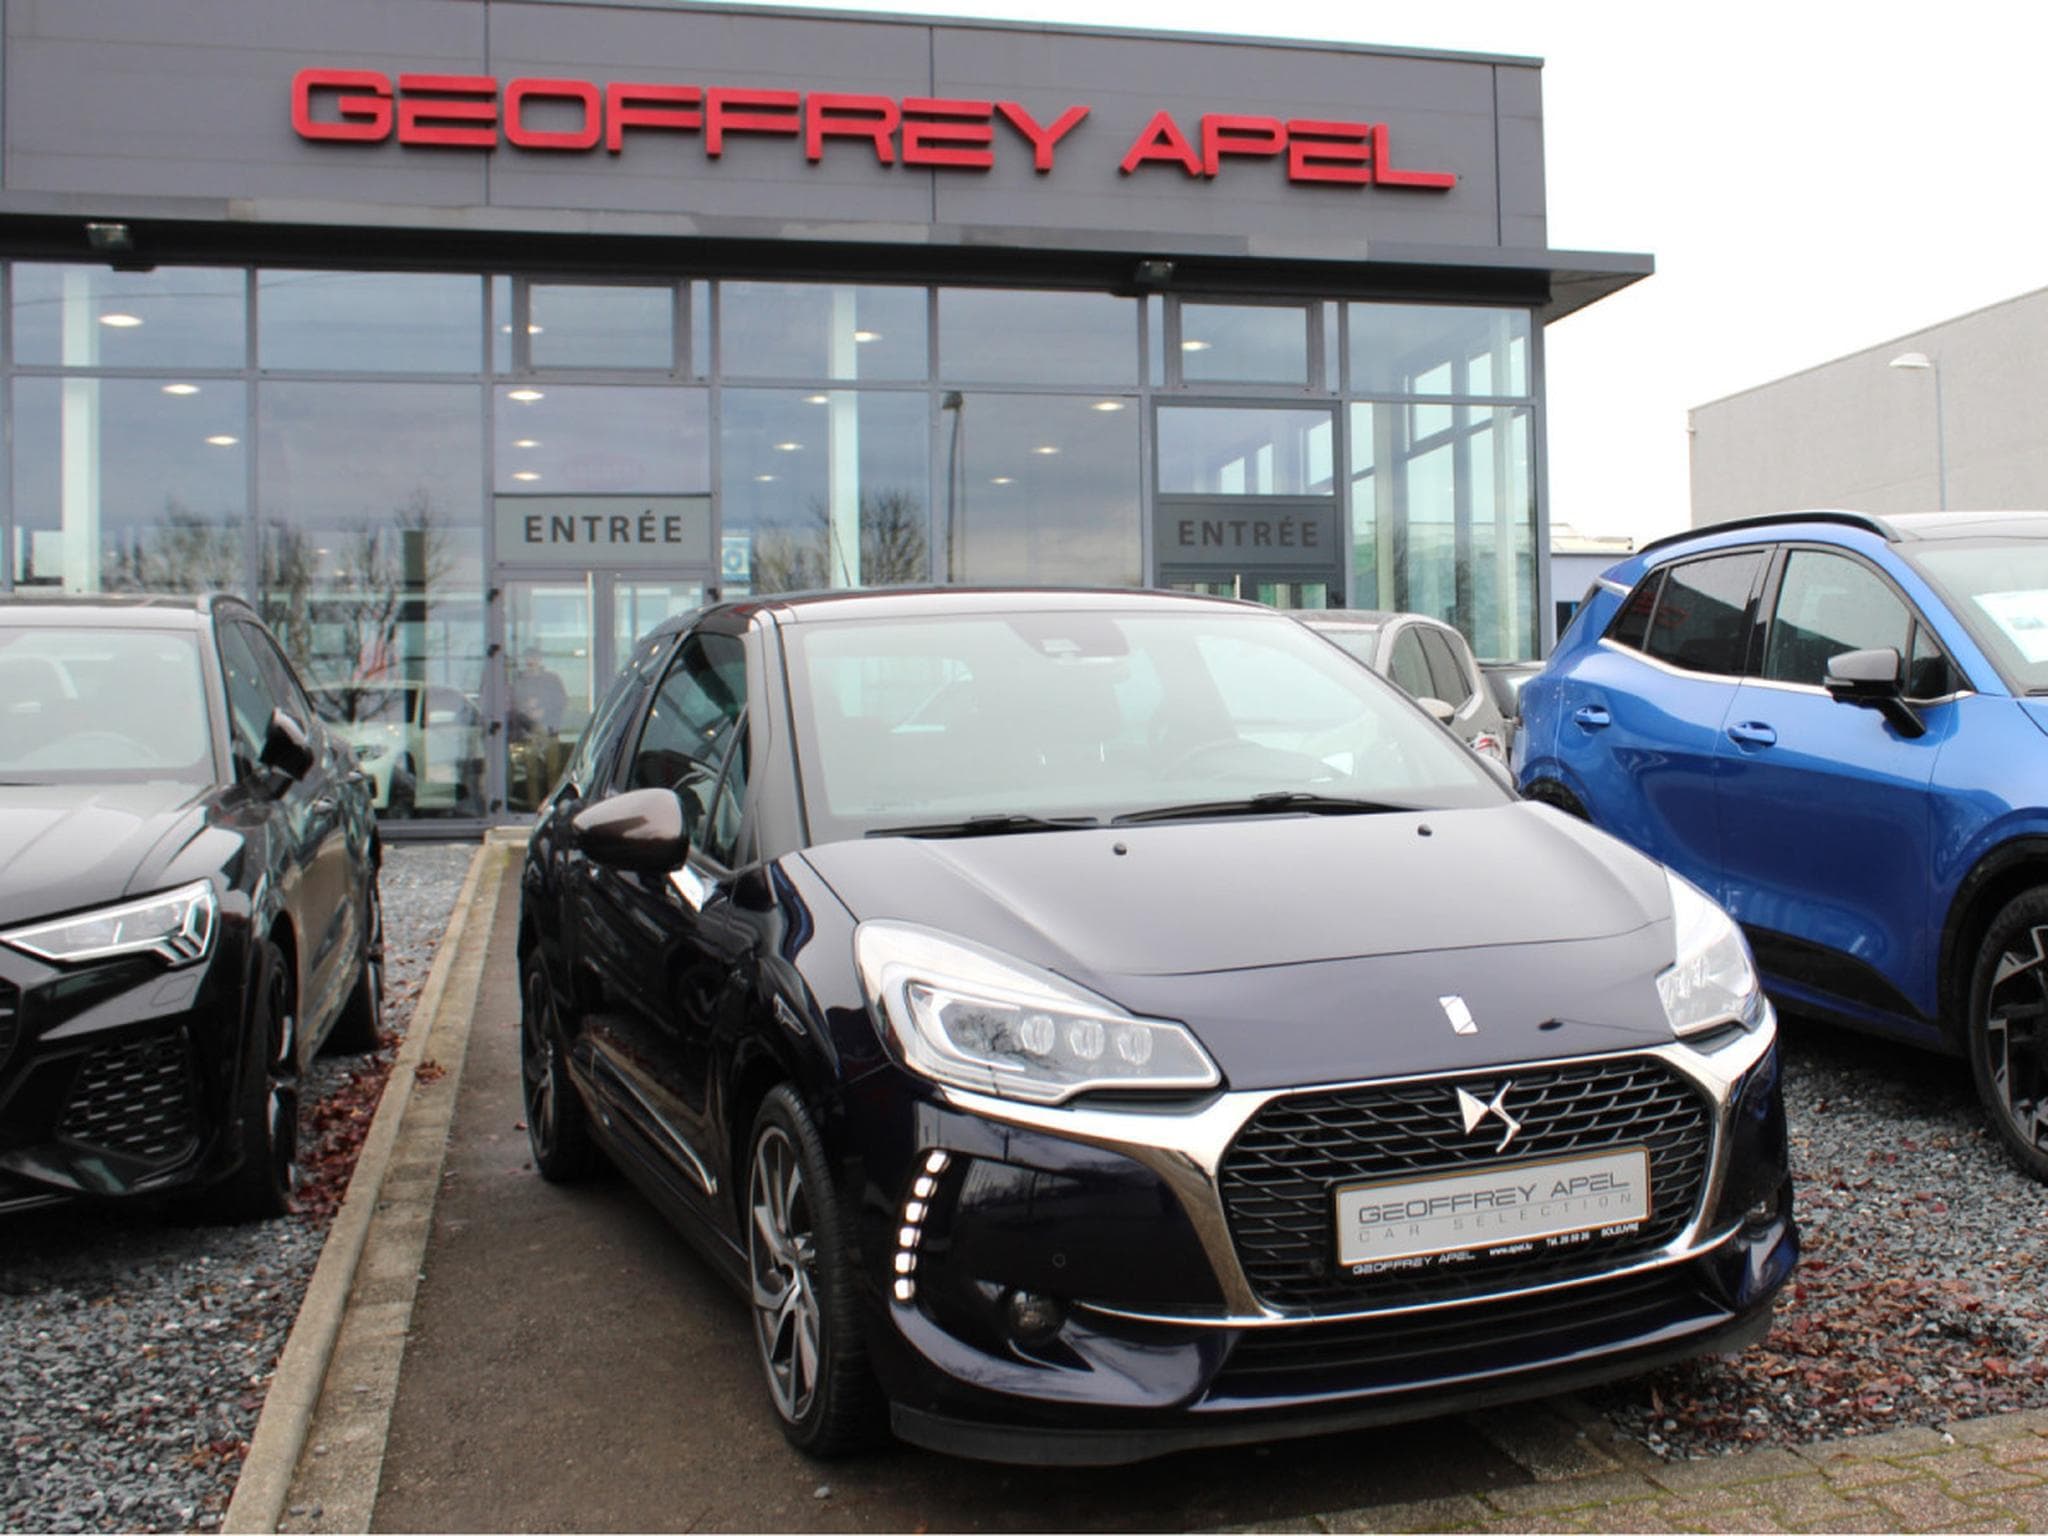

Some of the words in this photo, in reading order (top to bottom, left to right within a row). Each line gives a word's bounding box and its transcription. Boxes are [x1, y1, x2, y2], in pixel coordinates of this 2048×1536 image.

[290, 67, 1090, 173] GEOFFREY
[1119, 109, 1456, 191] APEL
[524, 509, 682, 543] ENTRÉE
[1177, 515, 1318, 547] ENTRÉE
[1358, 1183, 1537, 1226] GEOFFREY
[1550, 1171, 1631, 1199] APEL
[1359, 1223, 1421, 1244] CAR
[1453, 1191, 1633, 1232] SELECTION
[1352, 1255, 1433, 1276] GEOFFREY
